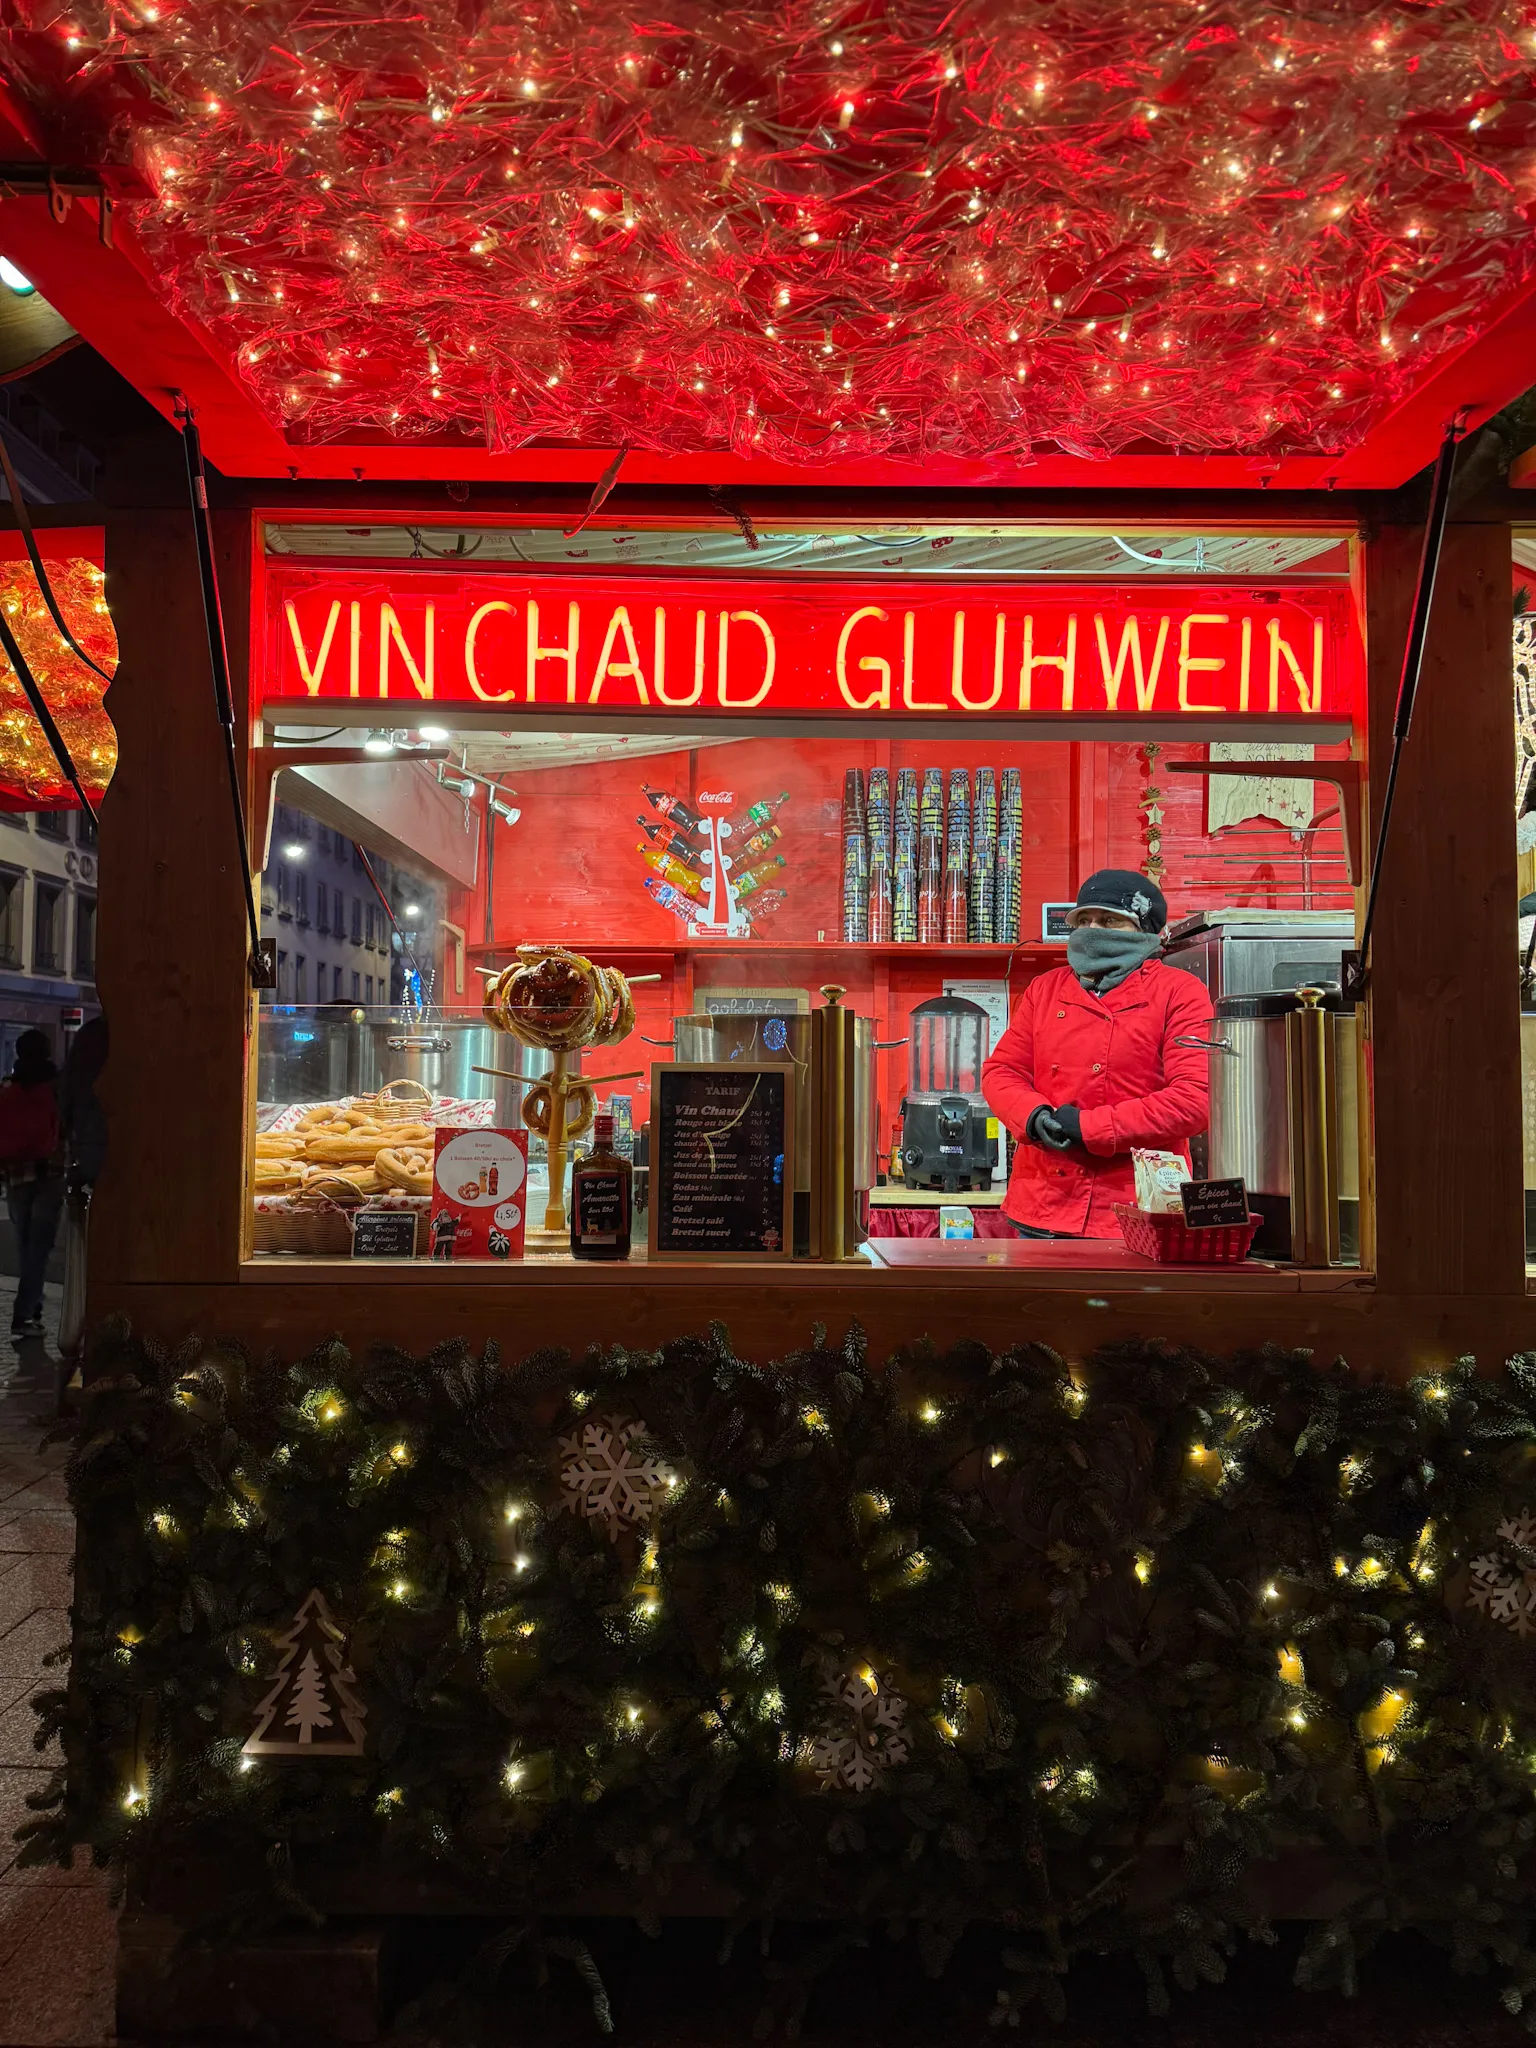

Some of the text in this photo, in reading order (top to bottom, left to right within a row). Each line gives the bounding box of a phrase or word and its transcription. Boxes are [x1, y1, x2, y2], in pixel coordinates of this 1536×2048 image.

[284, 600, 1324, 713] VIN CHAUD GLUHWEIN
[705, 1087, 741, 1096] TARIF
[674, 1105, 698, 1116] Vin
[674, 1119, 704, 1128] Rouge
[705, 1153, 738, 1161] pmme
[712, 1161, 737, 1169] pices
[673, 1171, 708, 1180] Boisson
[709, 1171, 748, 1180] cacaotée
[583, 1181, 618, 1190] Vin Chaud
[672, 1183, 700, 1191] Sodas
[1198, 1184, 1230, 1200] Épices
[582, 1193, 620, 1203] Amaretto
[672, 1193, 690, 1201] Eau
[691, 1193, 732, 1201] minérale
[672, 1204, 693, 1213] Café
[1189, 1199, 1243, 1213] pour vin chaud
[671, 1216, 705, 1224] Bretzel
[706, 1216, 725, 1225] salé
[671, 1228, 705, 1236] Bretzel
[705, 1228, 731, 1237] sucré
